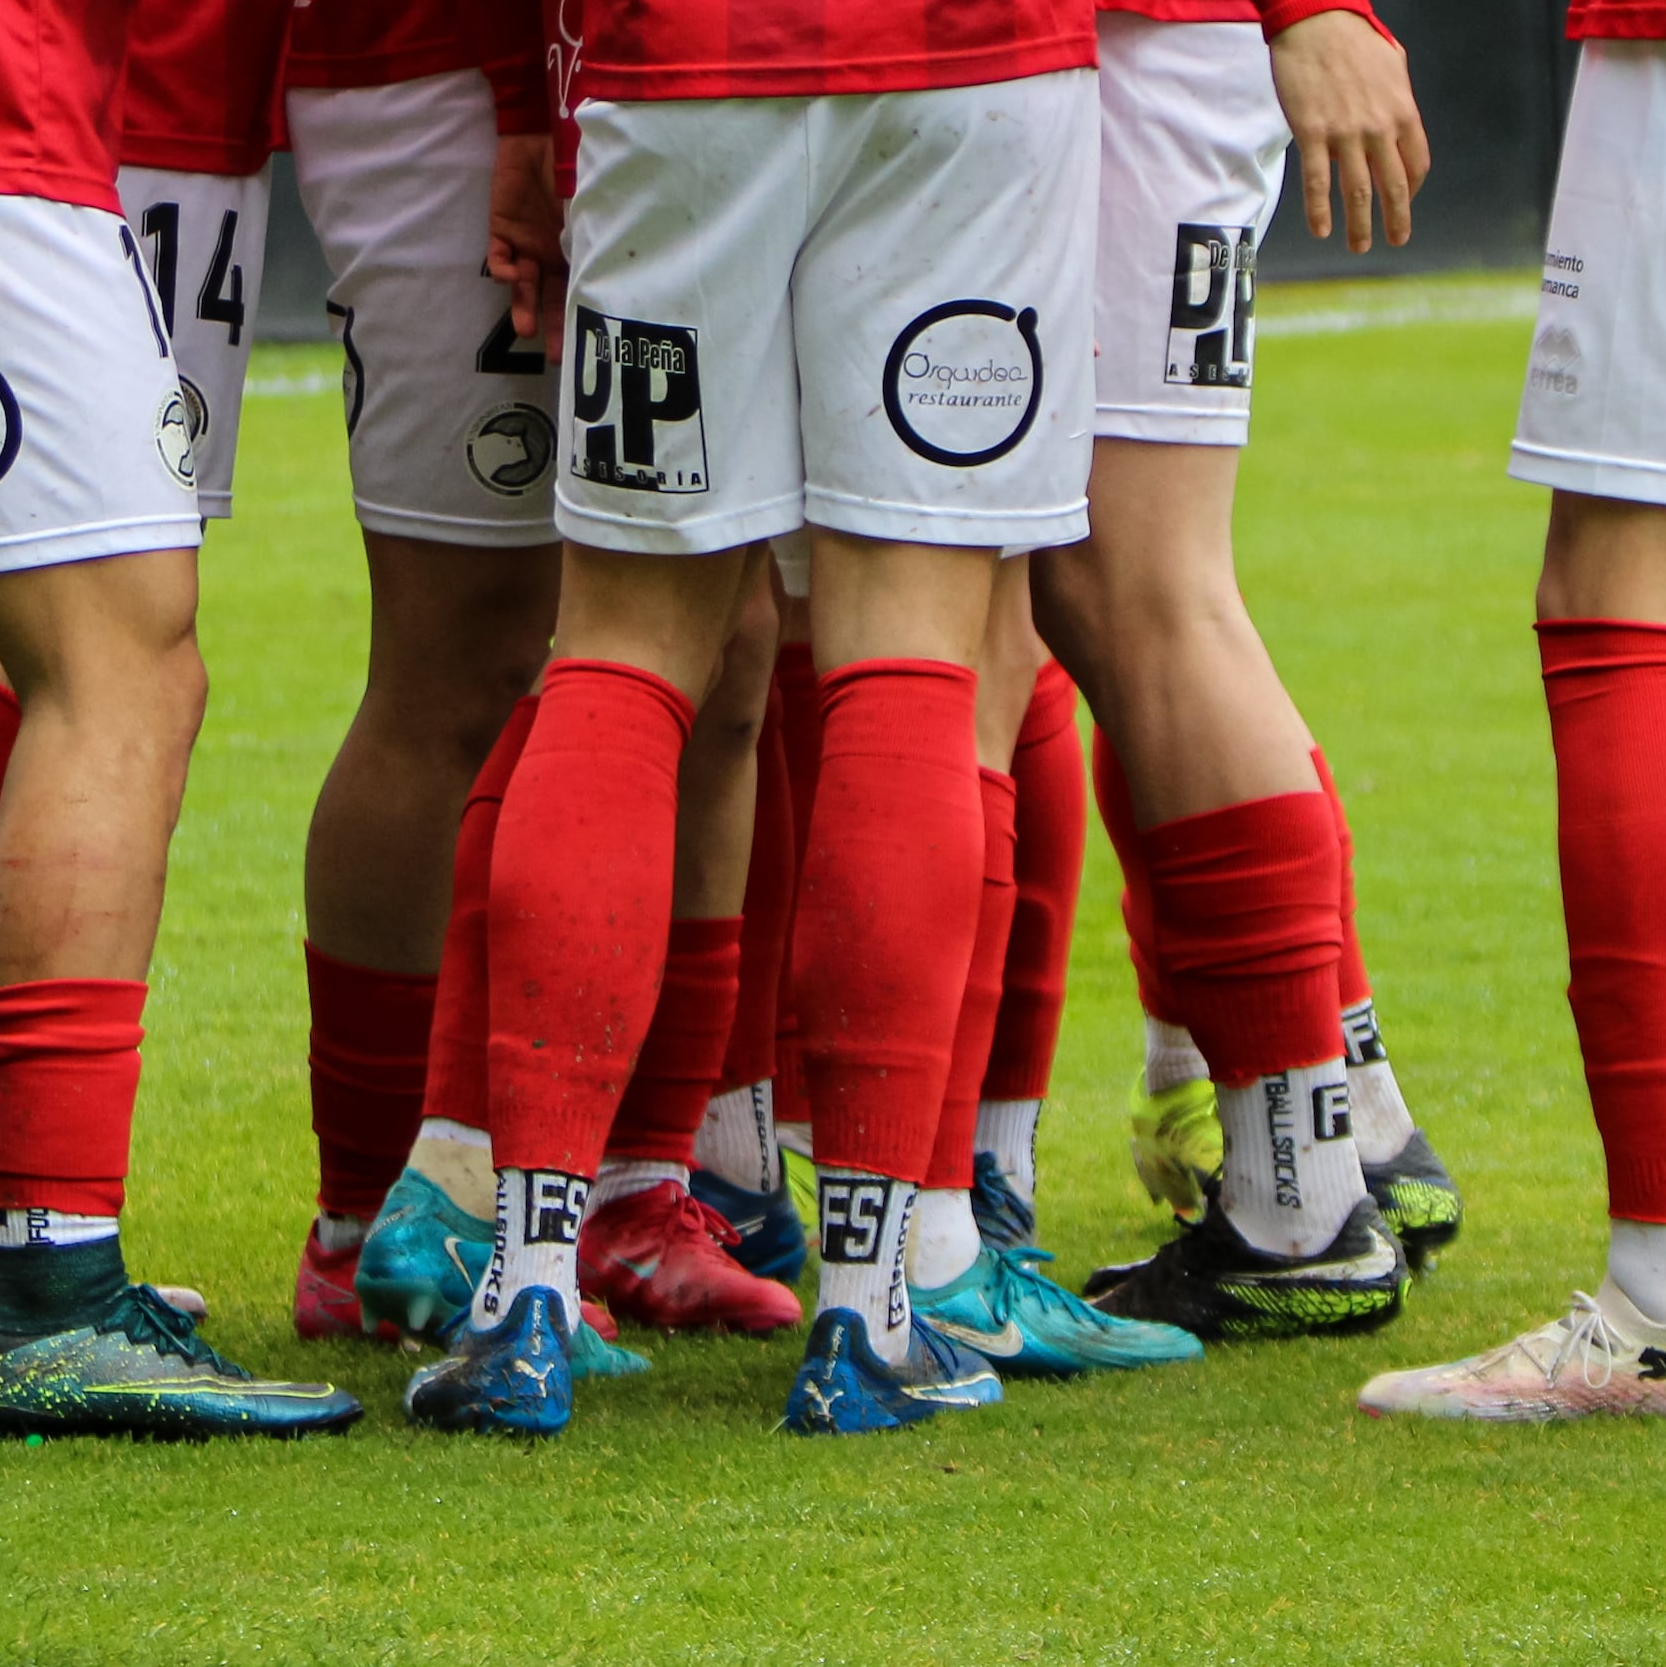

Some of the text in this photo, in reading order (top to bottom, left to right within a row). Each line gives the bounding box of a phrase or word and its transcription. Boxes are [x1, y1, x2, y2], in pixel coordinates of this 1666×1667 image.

[142, 200, 245, 347] 14
[614, 336, 633, 367] la
[638, 337, 686, 374] Peña
[908, 391, 1023, 407] restaurante
[531, 1172, 590, 1243] FS
[821, 1183, 884, 1260] FS
